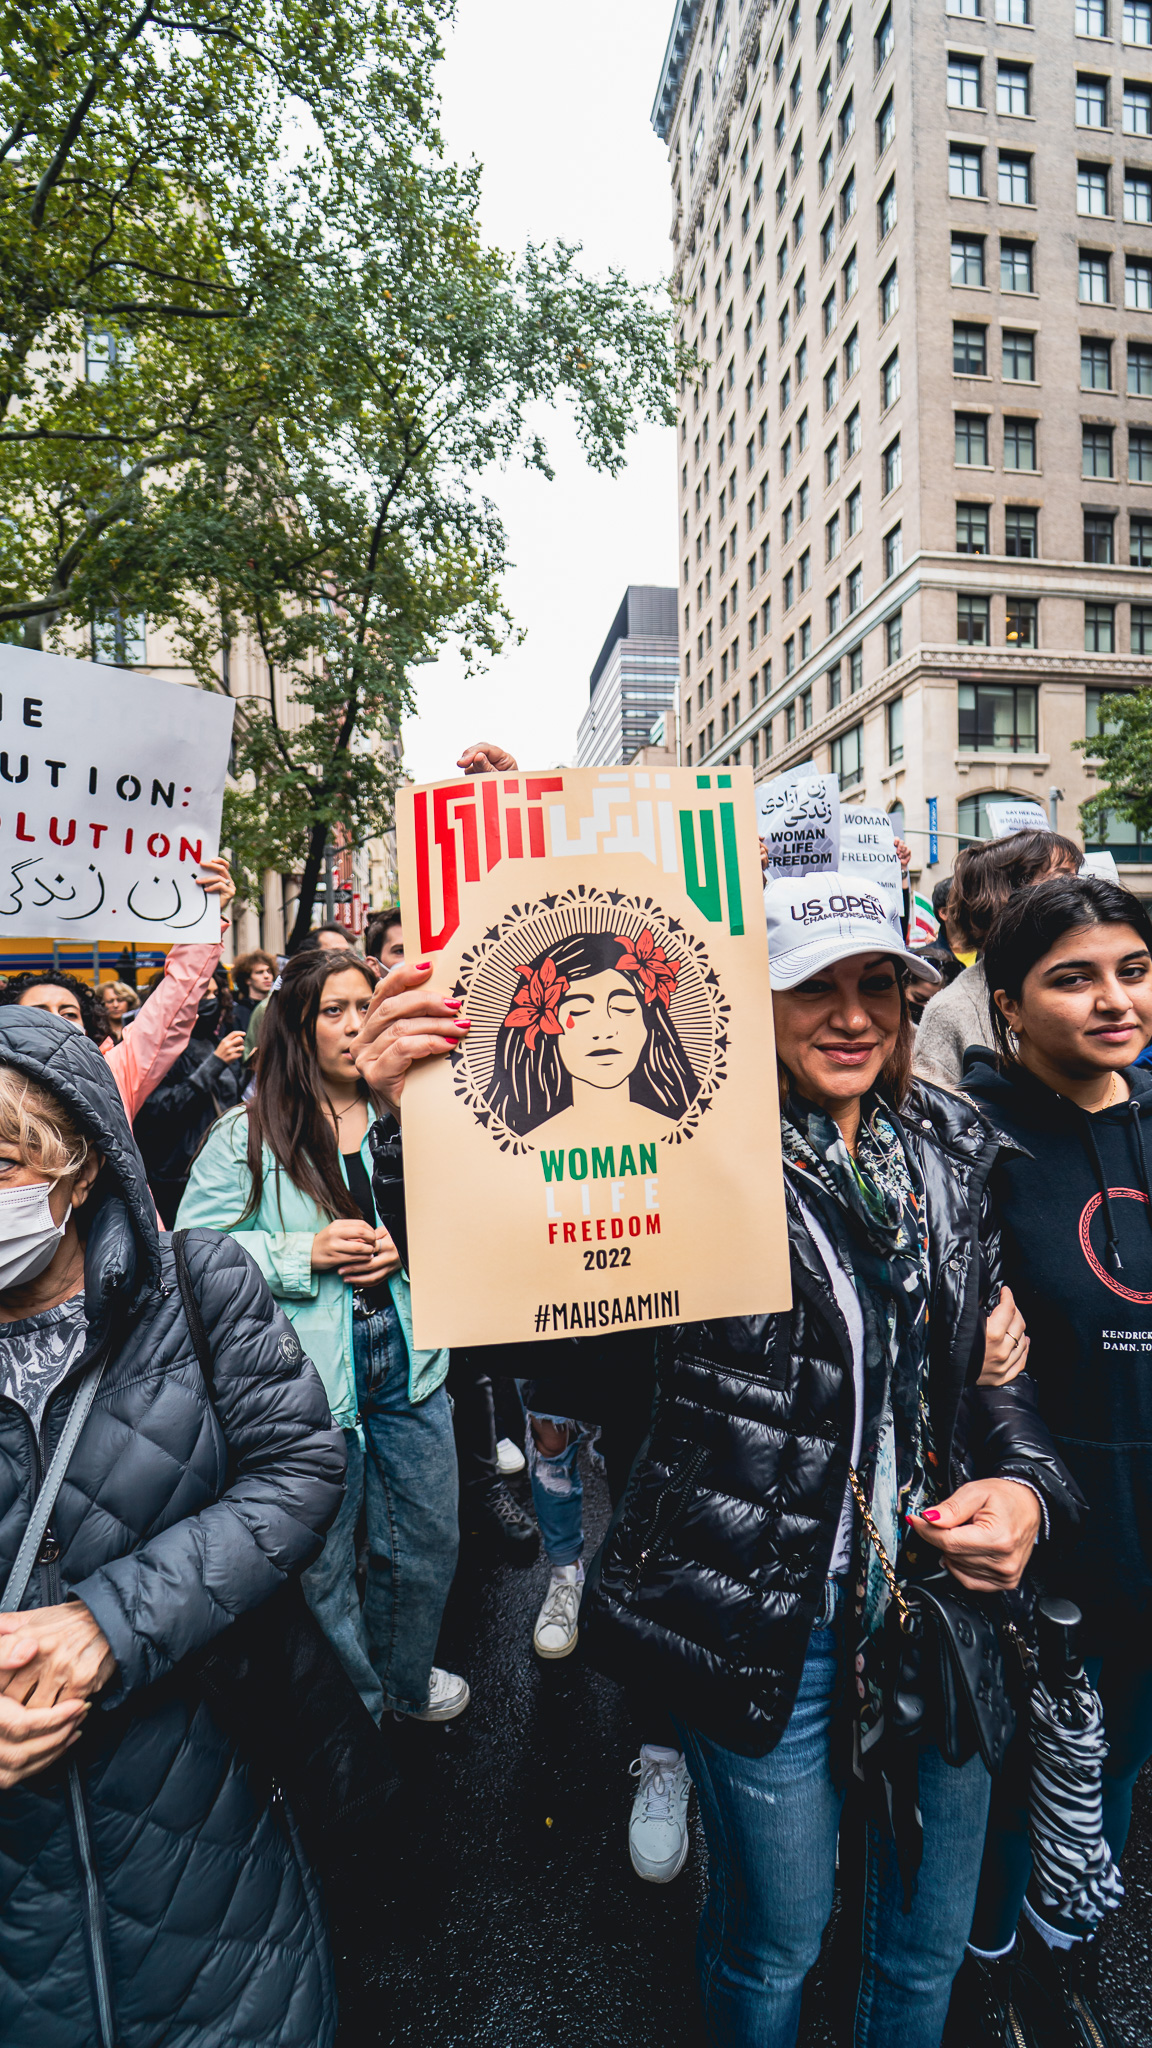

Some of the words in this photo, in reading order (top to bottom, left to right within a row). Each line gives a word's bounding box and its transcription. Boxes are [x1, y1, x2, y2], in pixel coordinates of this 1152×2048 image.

[761, 784, 798, 815] آزادی
[807, 780, 826, 799] زن
[844, 813, 890, 826] WOMAN
[0, 812, 202, 864] LUTION
[771, 828, 826, 843] WOMAN
[858, 834, 880, 844] LIFE
[783, 842, 814, 855] LIFE
[841, 851, 898, 863] FREEDOM
[790, 899, 824, 921] US
[828, 895, 887, 919] OPEN
[803, 911, 882, 926] CHAMPIONSHIPS
[540, 1142, 658, 1182] WOMAN
[545, 1178, 660, 1218] LIFE
[548, 1213, 662, 1244] FREEDOM
[583, 1246, 631, 1271] 2022
[534, 1290, 680, 1333] #MAHSAAMINI
[1103, 1341, 1140, 1352] DAMN.
